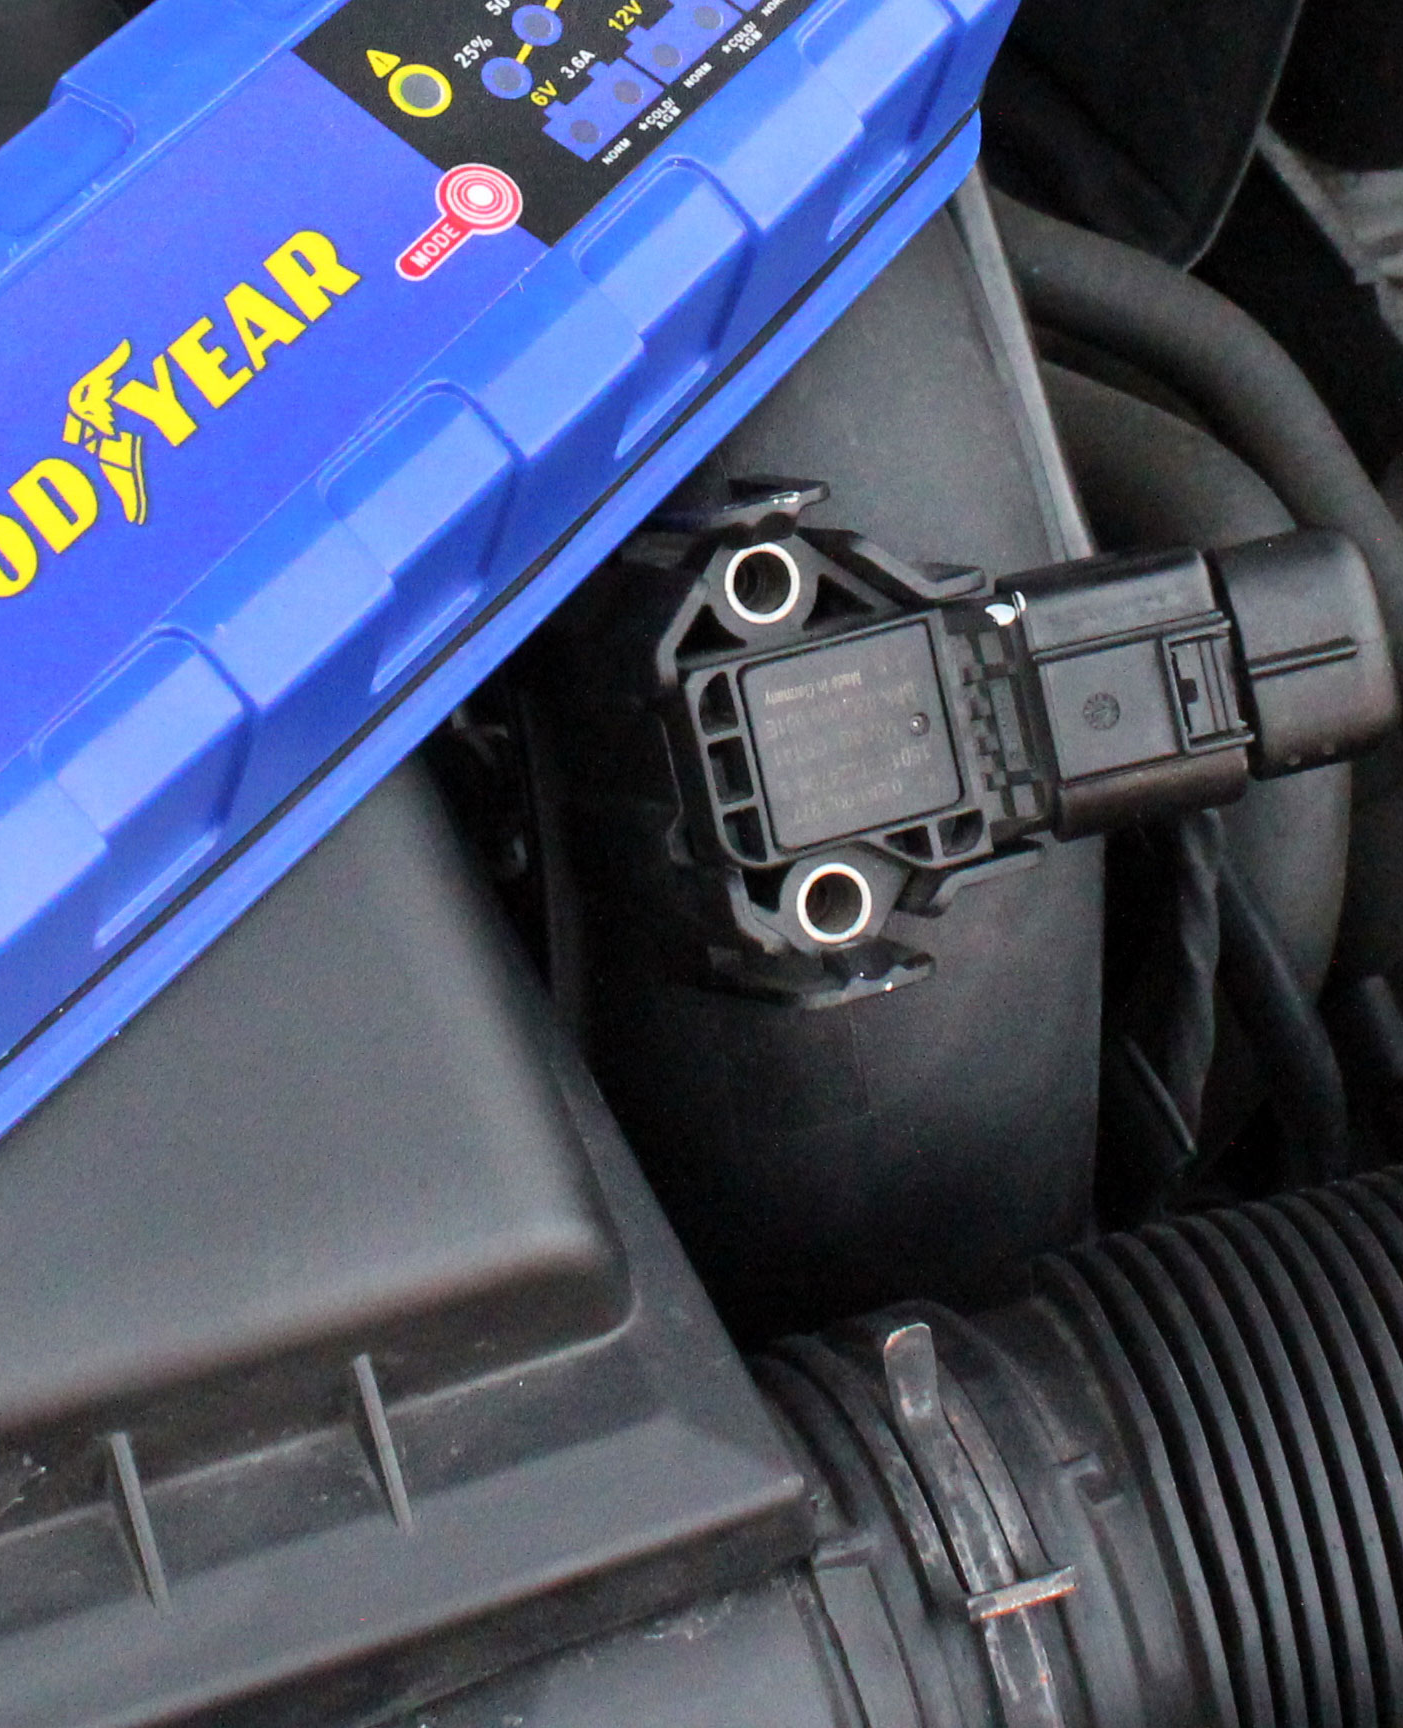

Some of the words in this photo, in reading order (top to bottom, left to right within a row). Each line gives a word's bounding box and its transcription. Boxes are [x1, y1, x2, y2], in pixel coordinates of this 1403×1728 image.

[453, 34, 494, 70] 25%
[530, 79, 558, 106] 6V
[560, 49, 596, 79] 3.6A
[683, 61, 713, 89] NORM
[601, 137, 633, 166] NORM
[409, 222, 461, 269] MODE
